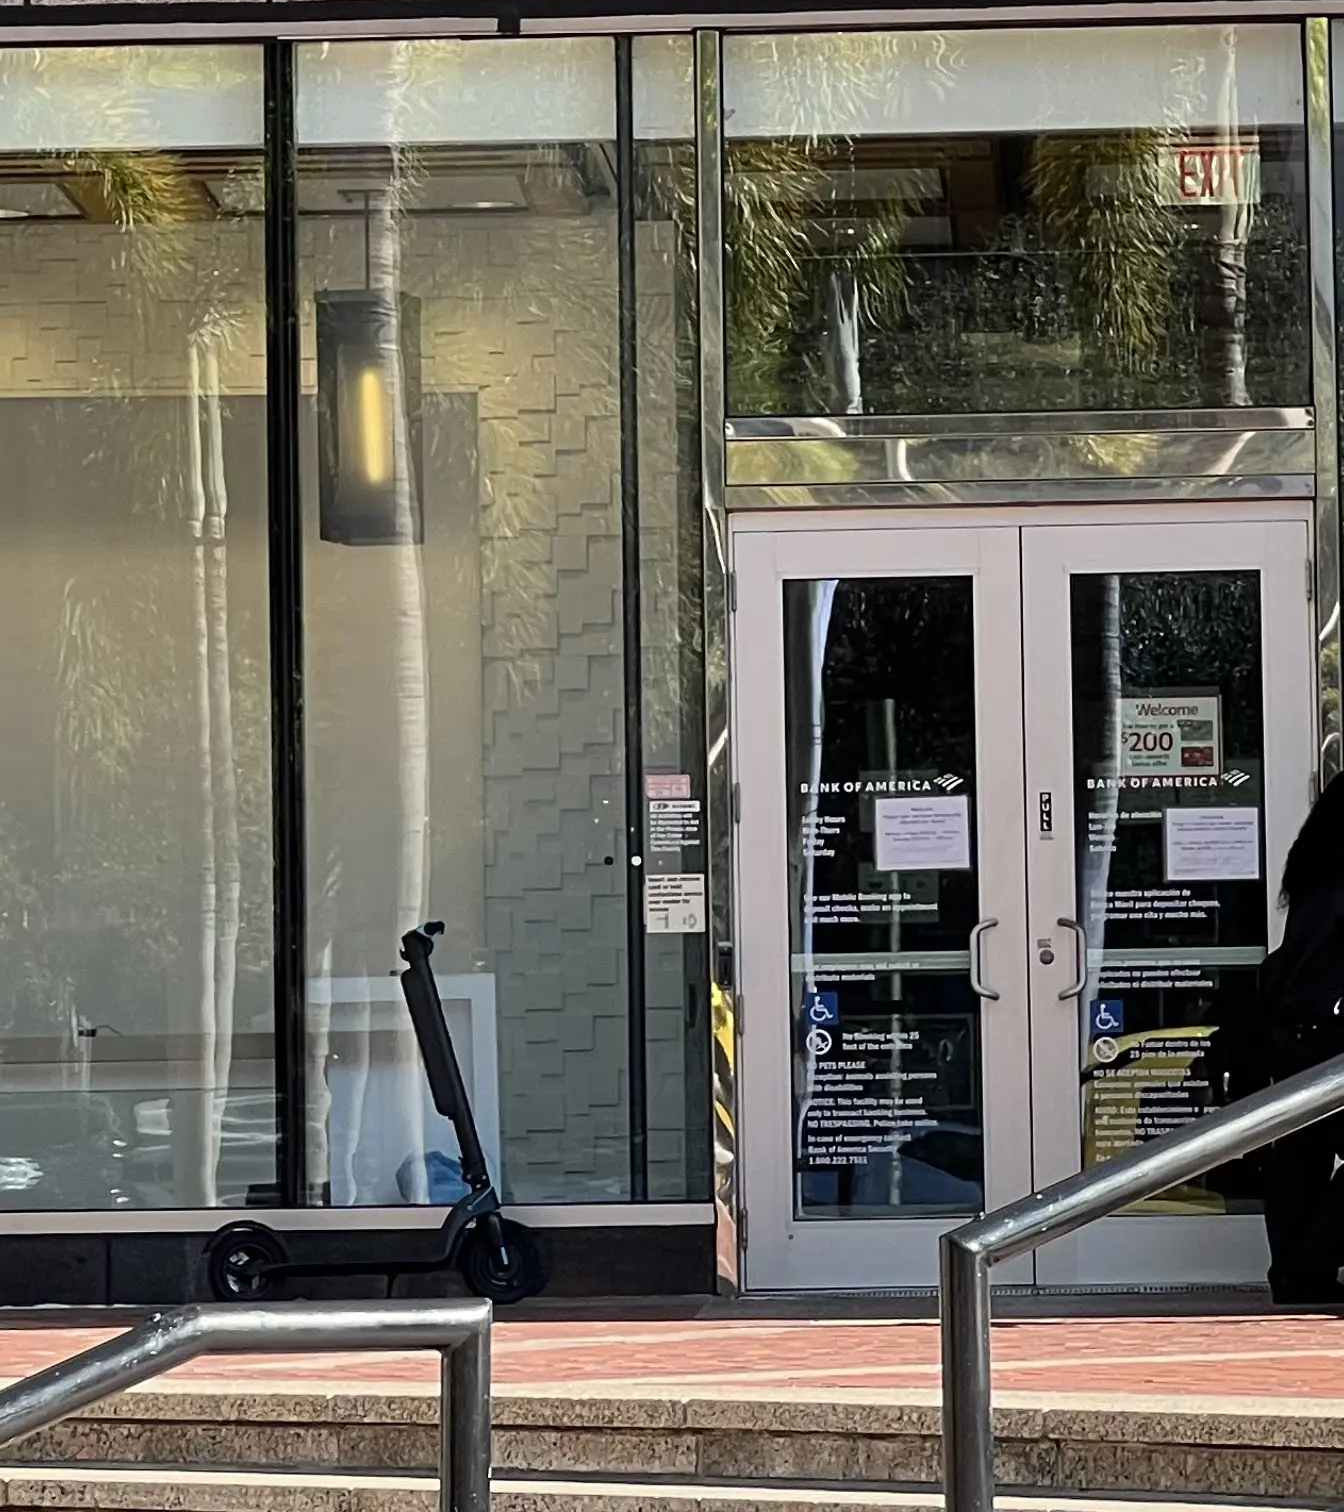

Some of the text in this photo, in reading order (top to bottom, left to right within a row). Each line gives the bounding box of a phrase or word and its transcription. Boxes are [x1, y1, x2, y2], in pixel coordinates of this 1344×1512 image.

[1180, 148, 1244, 198] EXIT
[1136, 703, 1198, 716] Welcome
[1121, 732, 1173, 751] $200
[843, 781, 862, 792] OF
[865, 780, 932, 792] AMERICA
[1087, 777, 1218, 789] BANK OF AMERICA
[1041, 794, 1050, 830] PULL
[838, 1061, 866, 1069] PLEASE
